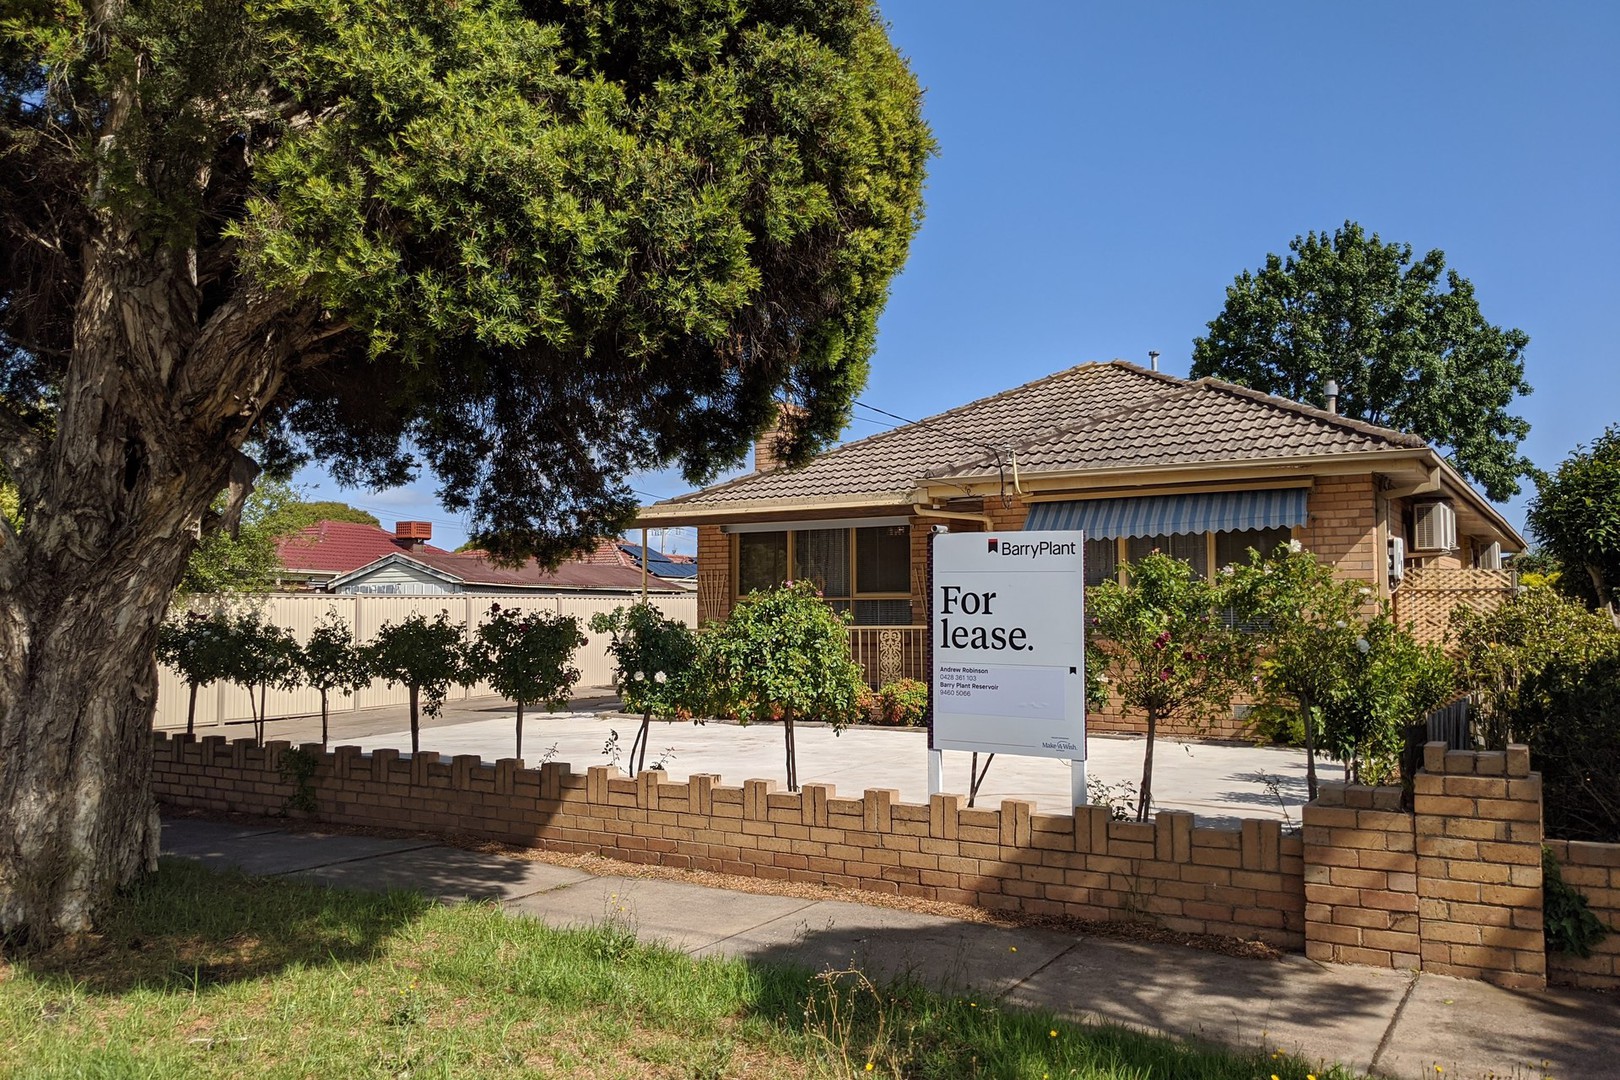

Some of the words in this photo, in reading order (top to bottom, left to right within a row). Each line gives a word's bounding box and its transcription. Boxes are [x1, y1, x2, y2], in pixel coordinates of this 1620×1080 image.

[1001, 541, 1076, 558] BarryPlant
[940, 586, 996, 615] For
[940, 618, 1034, 651] lease.
[940, 681, 955, 689] Barry
